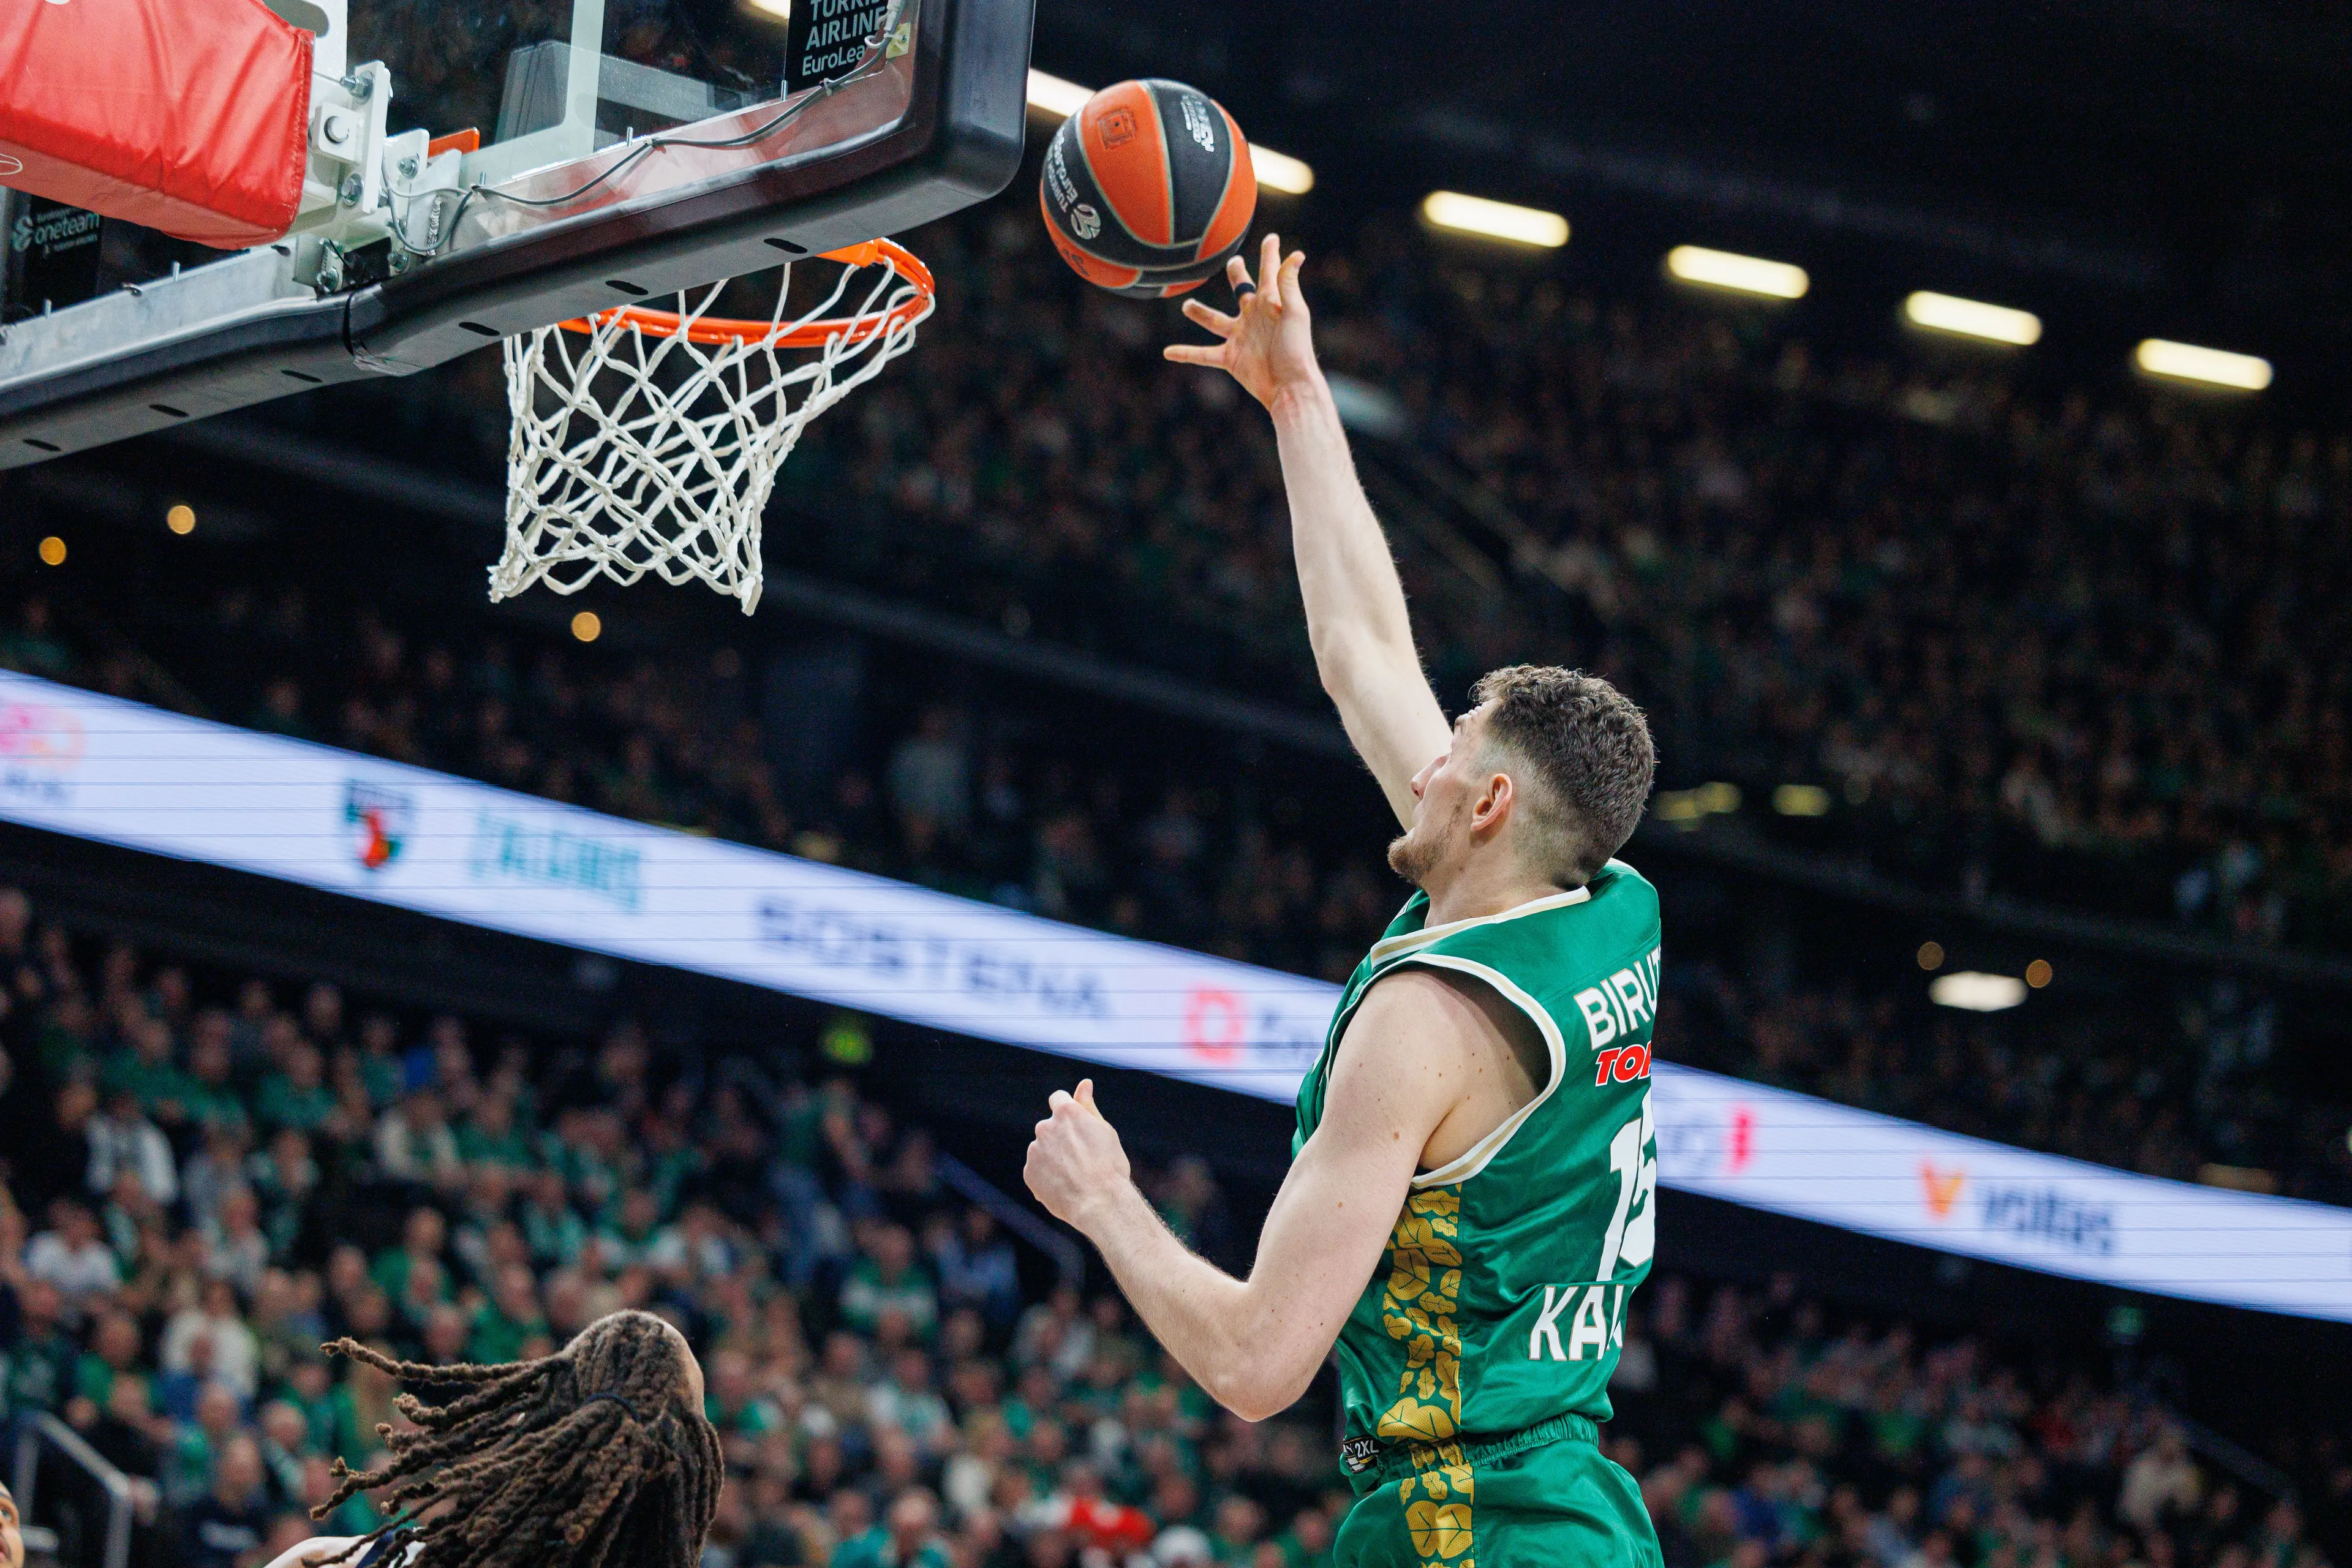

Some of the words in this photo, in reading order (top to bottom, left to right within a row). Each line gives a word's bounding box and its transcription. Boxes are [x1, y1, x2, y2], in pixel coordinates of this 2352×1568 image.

[1574, 943, 1661, 1052] BIRUT
[1595, 1085, 1657, 1283] 15
[1355, 1439, 1379, 1458] 2XL
